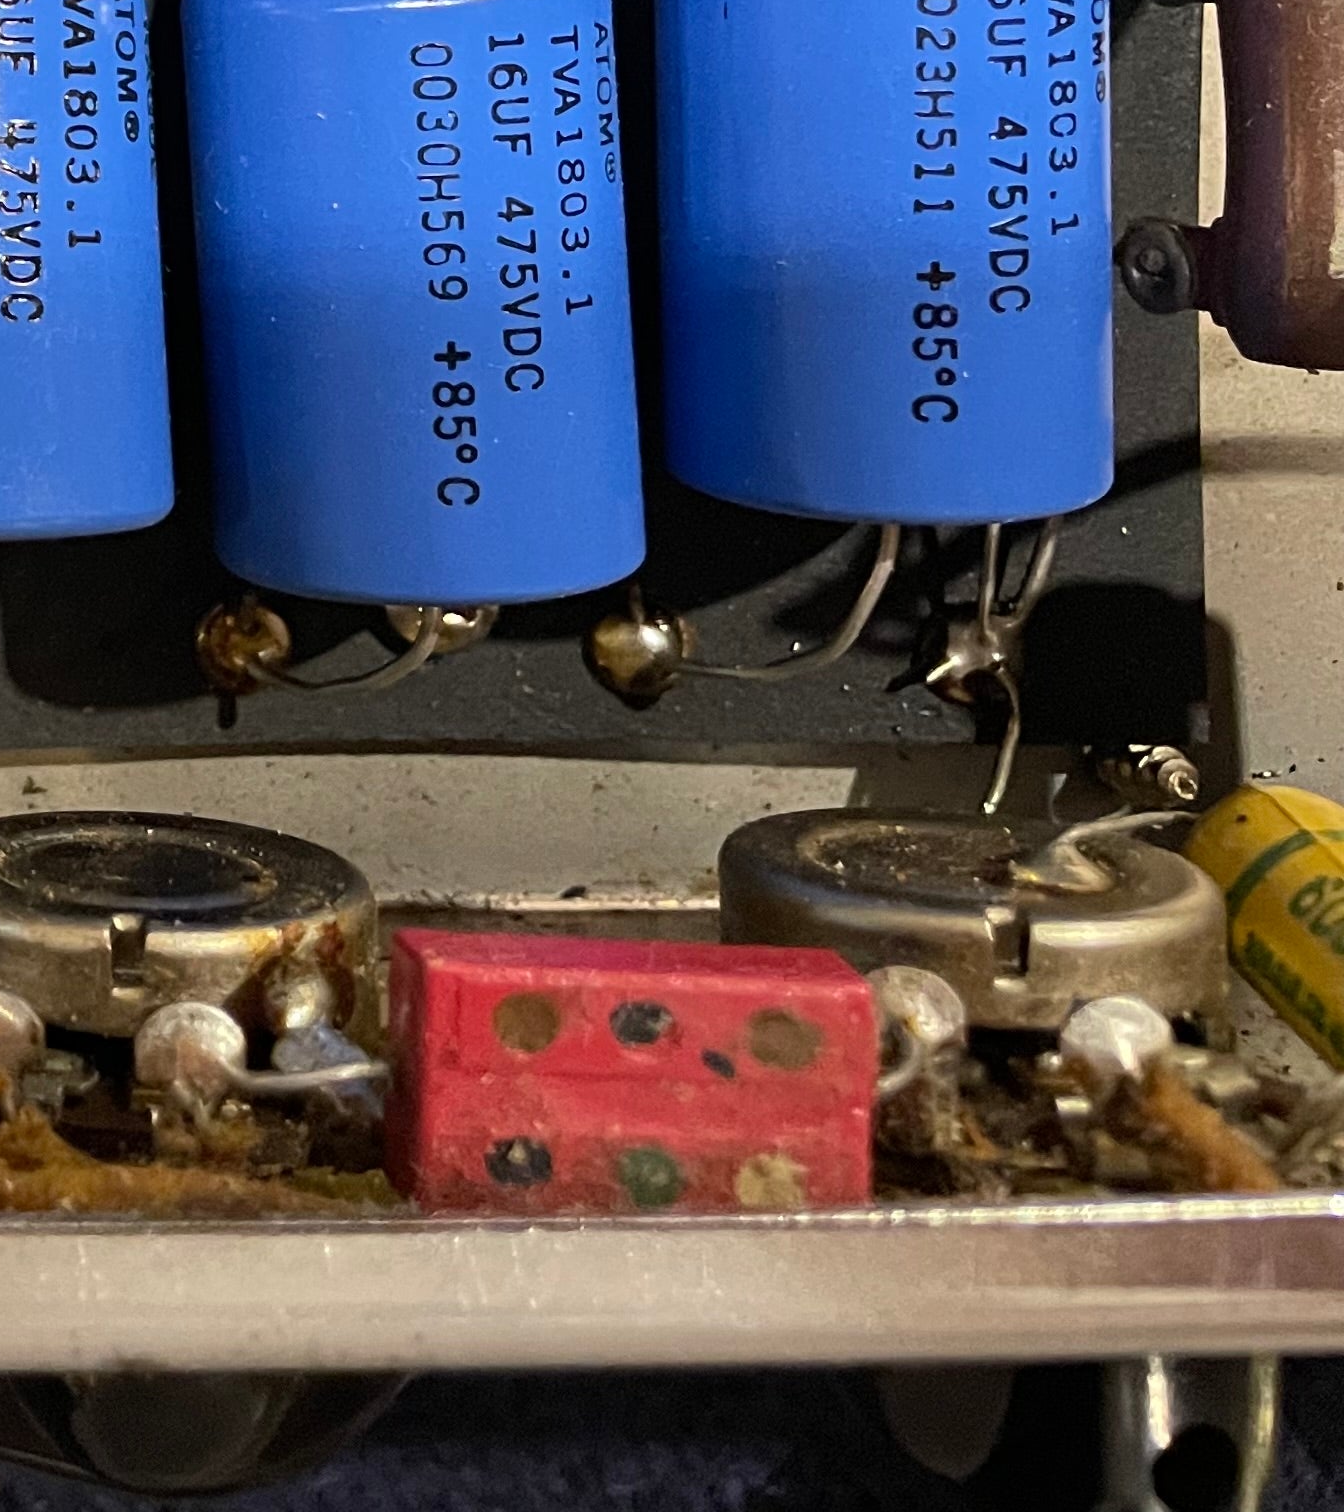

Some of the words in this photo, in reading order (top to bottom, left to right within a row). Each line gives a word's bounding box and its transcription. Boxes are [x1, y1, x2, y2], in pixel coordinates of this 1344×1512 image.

[410, 43, 469, 301] 0030H569
[487, 33, 532, 156] 16UF
[550, 26, 593, 316] TVA1803.1
[498, 196, 545, 393] 475VDC
[987, 116, 1030, 314] 475VDC
